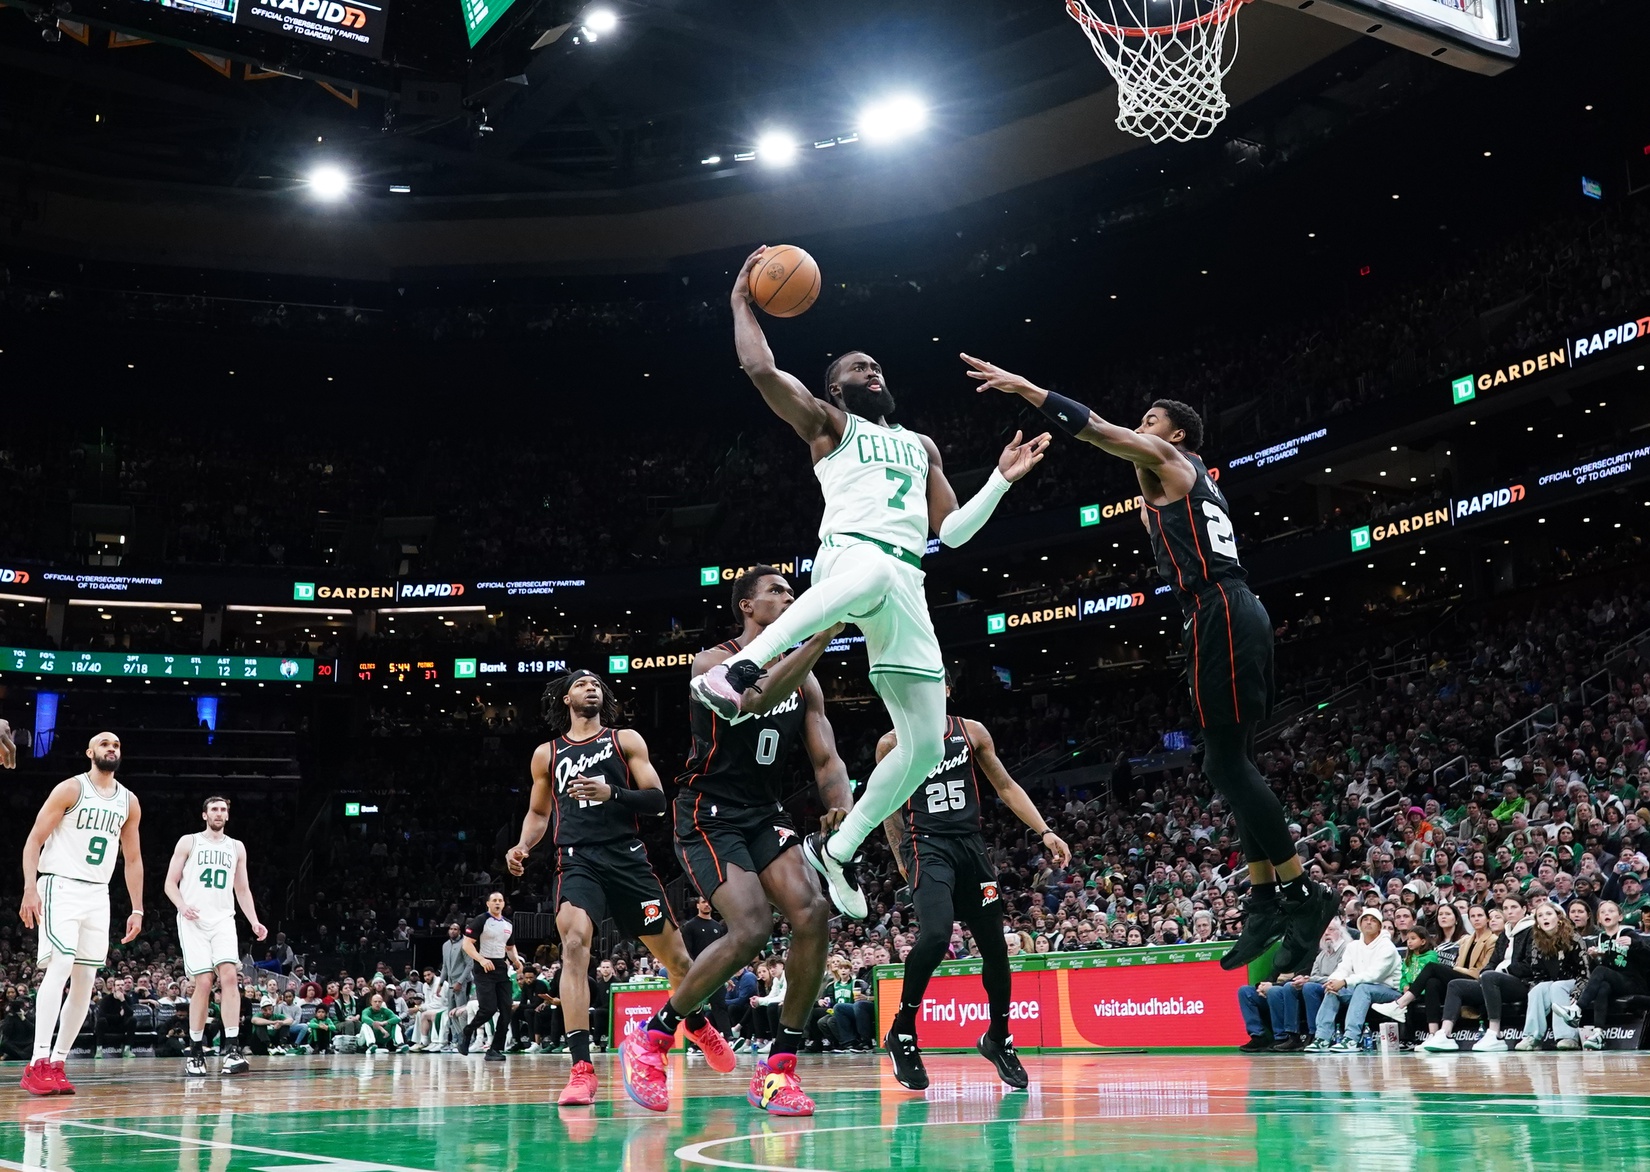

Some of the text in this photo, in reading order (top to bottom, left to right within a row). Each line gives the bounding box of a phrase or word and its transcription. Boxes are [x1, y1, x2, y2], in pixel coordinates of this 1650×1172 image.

[251, 7, 370, 43] OFFICIAL CYBERSECURITY PARTNER
[304, 29, 333, 41] GARDEN
[1453, 380, 1472, 399] TD
[1477, 348, 1565, 391] GARDEN
[857, 434, 928, 480] CELTICS
[1229, 428, 1327, 468] OFFICIAL CYBERSECURITY PARTNER
[1257, 447, 1298, 467] OF TD GARDEN
[1538, 470, 1571, 485] OFFICIAL
[1572, 451, 1634, 476] CYBERSECURITY
[1576, 462, 1631, 485] OF TD GARDEN
[885, 467, 913, 511] 7
[1082, 496, 1143, 523] TD GARD
[1352, 484, 1525, 547] TD GARDEN RAPID7
[43, 573, 75, 581] OFFICIAL
[75, 574, 131, 584] CYBERSECURITY
[131, 577, 163, 585] PARTNER
[505, 580, 557, 588] CYBERSECURITY
[556, 579, 586, 587] PARTNER
[703, 570, 718, 582] TD
[722, 562, 794, 580] GAN
[295, 583, 465, 598] TD GARDEN RAPID7
[527, 587, 554, 595] GARDEN
[989, 616, 1005, 631] TD
[1007, 605, 1077, 628] GARDEN
[1083, 592, 1145, 615] RAPID7
[15, 659, 332, 677] 5 45 18/40 9/18 4 1 12 24 20
[389, 662, 411, 673] 5:44
[456, 660, 565, 675] TD Bank 8:19 PM
[611, 658, 627, 670] TD
[358, 670, 437, 682] 47 2 37
[756, 728, 780, 766] 0
[555, 742, 613, 794] Detroit
[928, 744, 969, 779] etroit
[925, 779, 967, 814] 25
[76, 807, 125, 837] CELTICS
[85, 835, 109, 866] 9
[197, 849, 233, 869] CELTICS
[199, 867, 228, 890] 40
[922, 998, 955, 1022] Find
[1009, 1000, 1039, 1020] ace
[1094, 996, 1204, 1018] visitabudhabi.ae
[1451, 1029, 1480, 1041] etBlue
